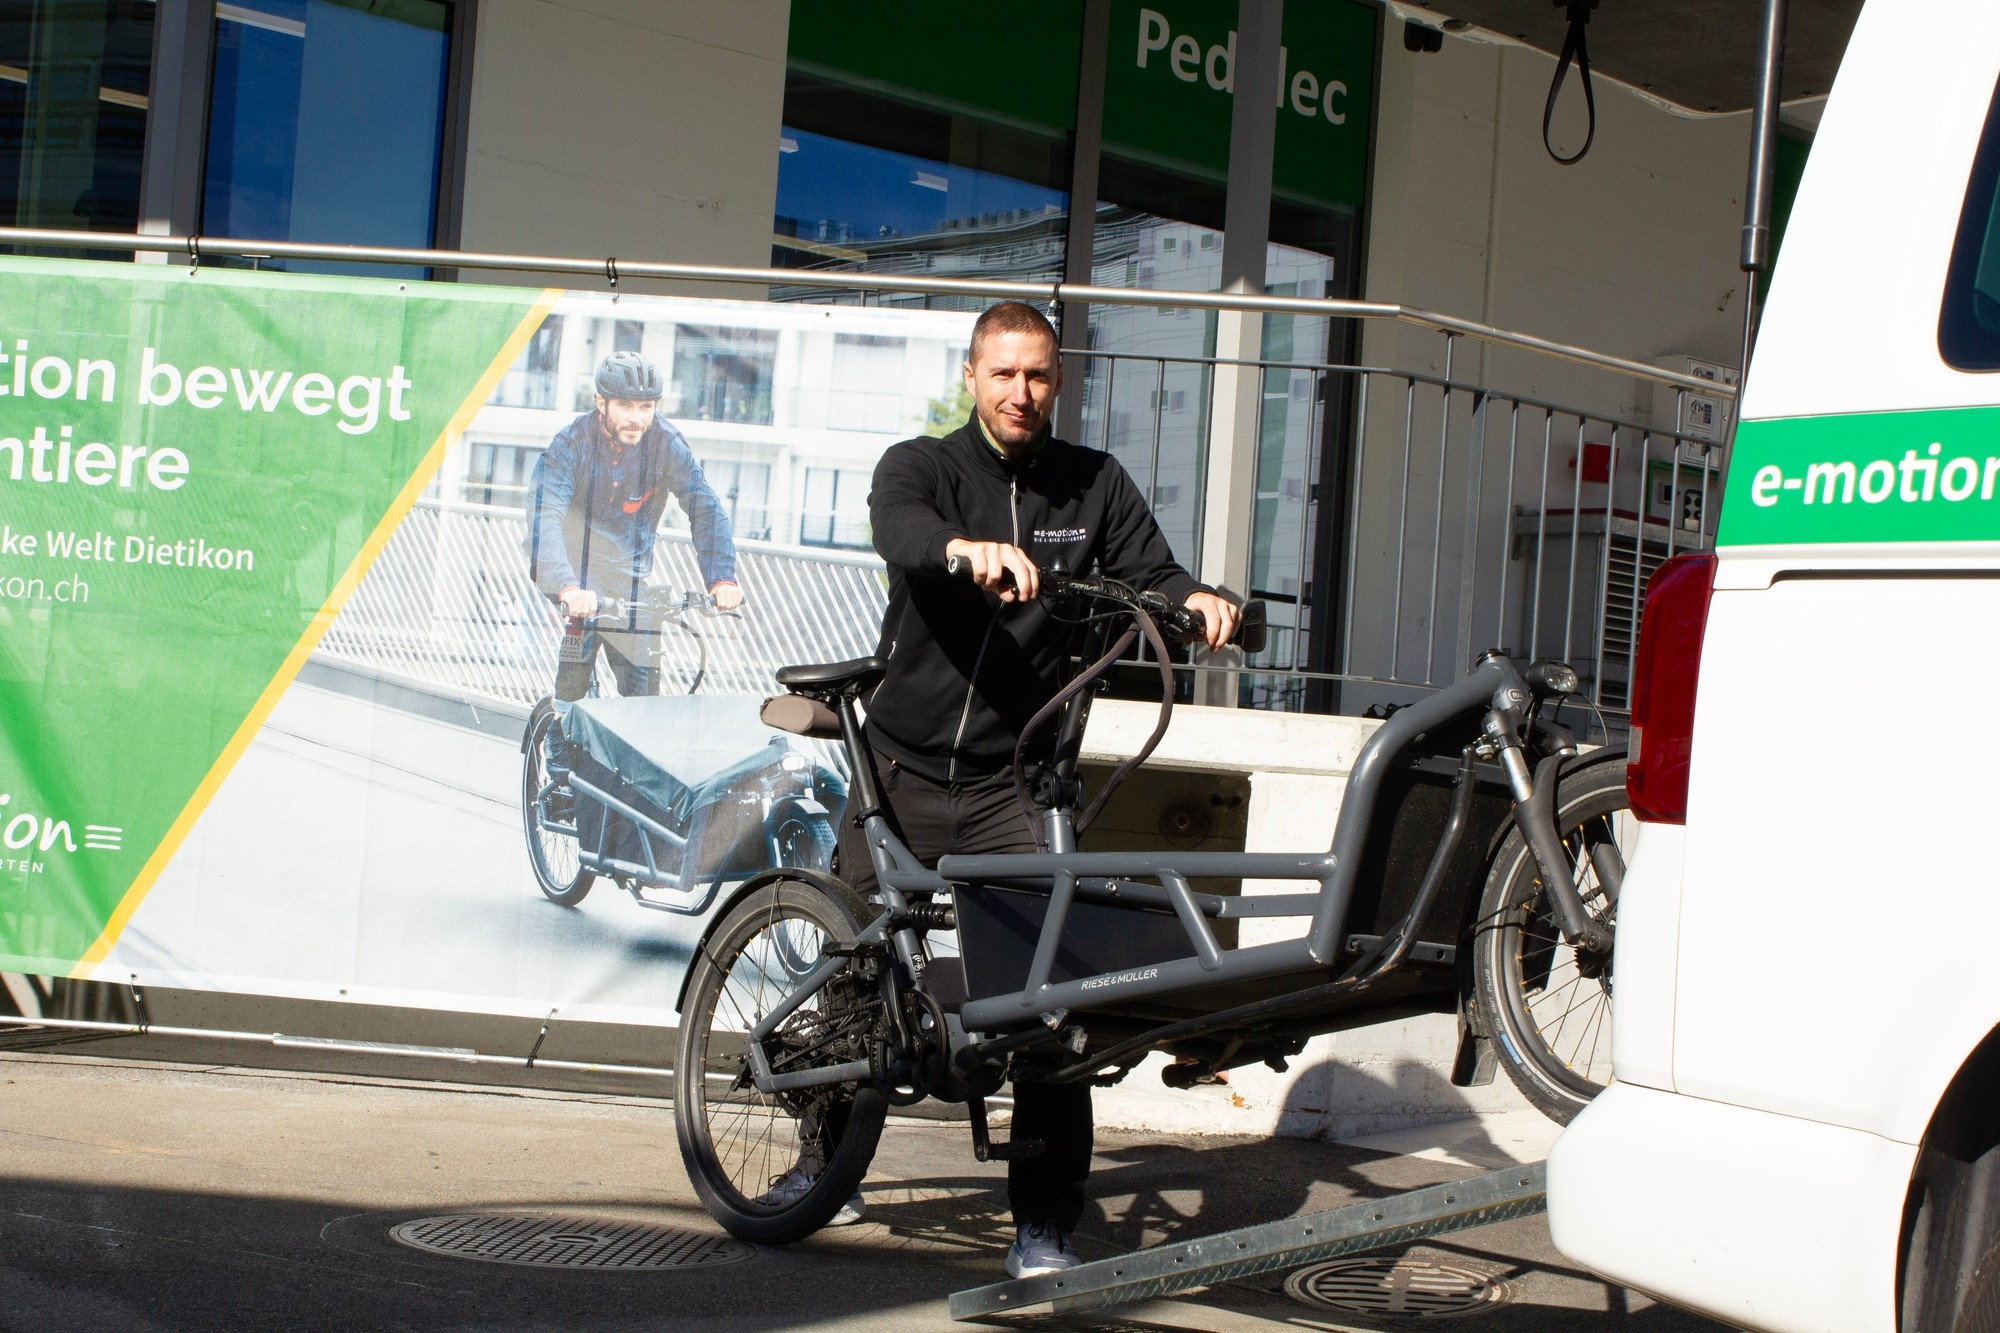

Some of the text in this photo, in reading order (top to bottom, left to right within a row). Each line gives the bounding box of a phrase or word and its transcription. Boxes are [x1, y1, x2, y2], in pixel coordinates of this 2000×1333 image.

[1137, 8, 1348, 125] Pedlec
[139, 347, 411, 435] bewegt
[2, 525, 254, 571] ke Welt Dietikon
[1040, 527, 1079, 538] e-motion
[0, 573, 89, 603] on.ch
[1520, 1064, 1561, 1102] SCHWALBE
